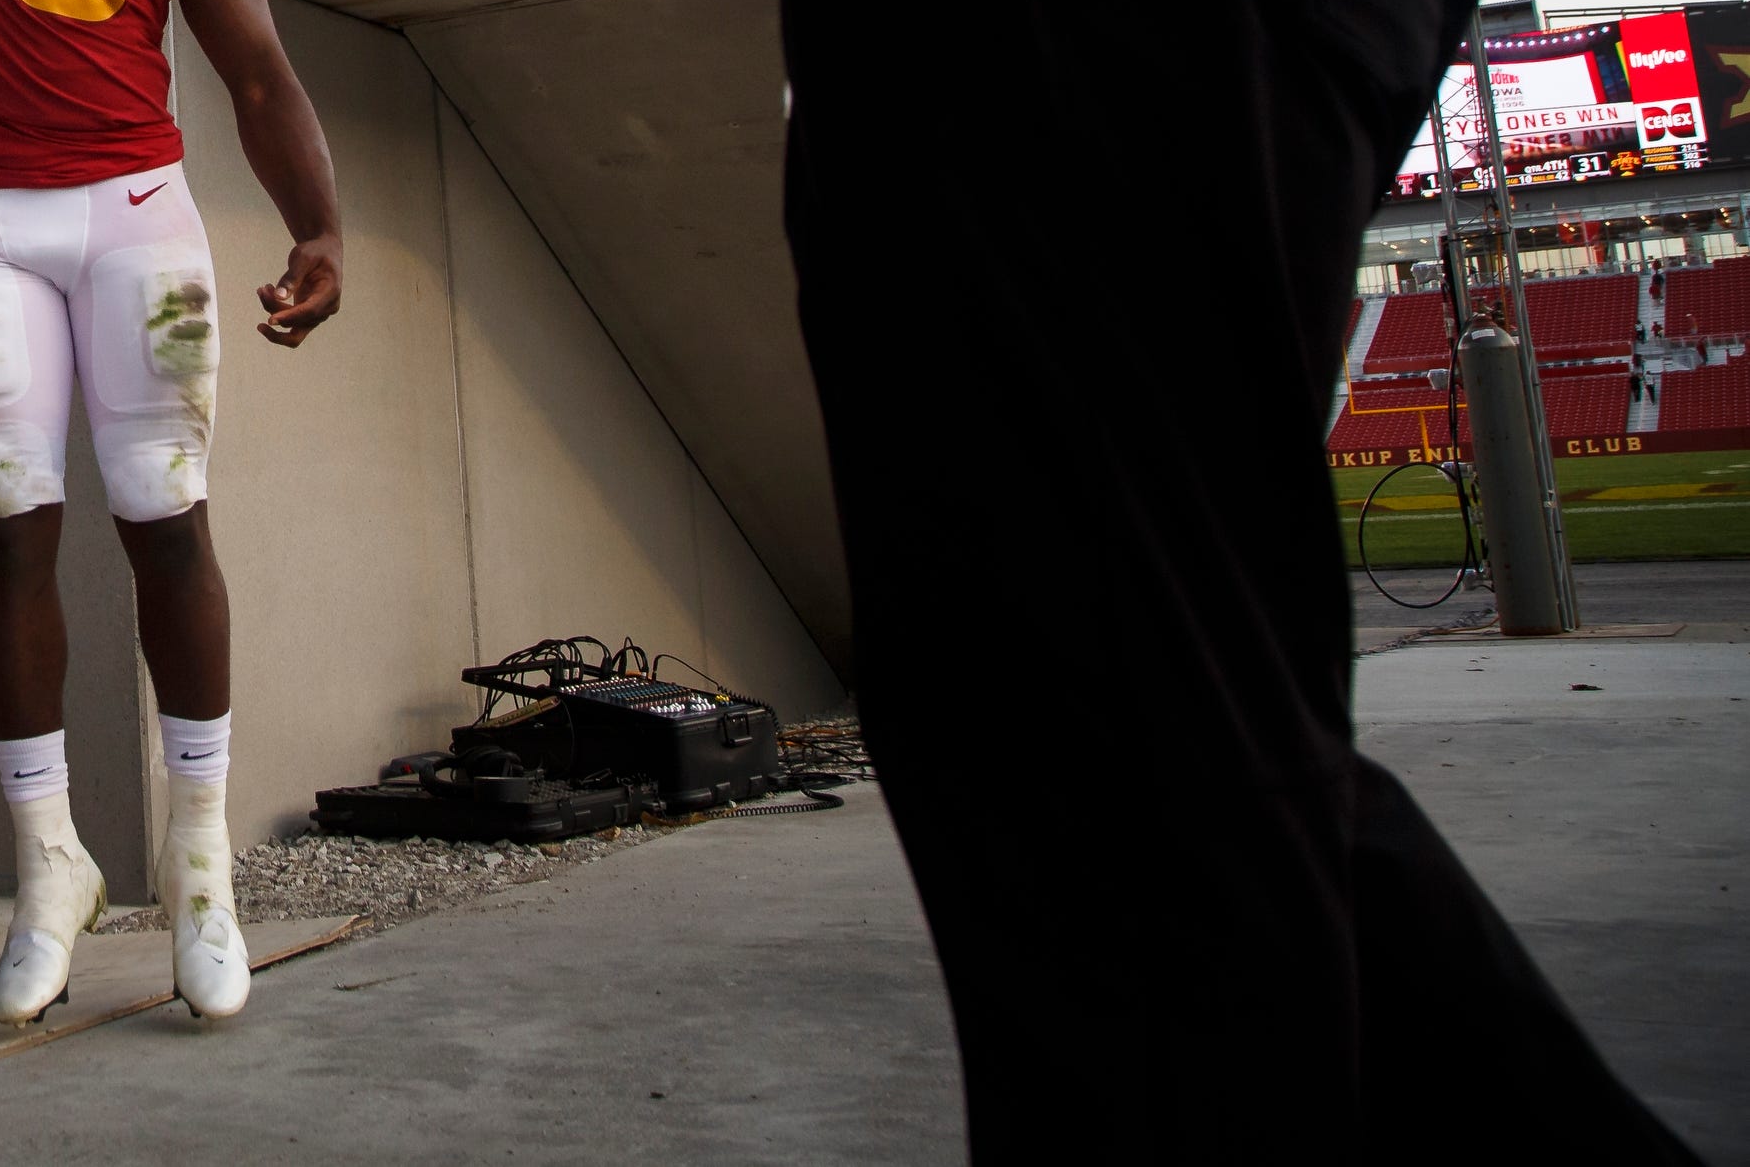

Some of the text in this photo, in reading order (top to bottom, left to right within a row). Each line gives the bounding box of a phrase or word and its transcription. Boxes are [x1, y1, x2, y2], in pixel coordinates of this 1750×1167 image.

[1443, 107, 1619, 137] YCONES WIN
[1643, 112, 1693, 130] CENEX
[1543, 159, 1568, 172] 4TH
[1578, 156, 1601, 172] 31
[1566, 436, 1643, 455] CLUB
